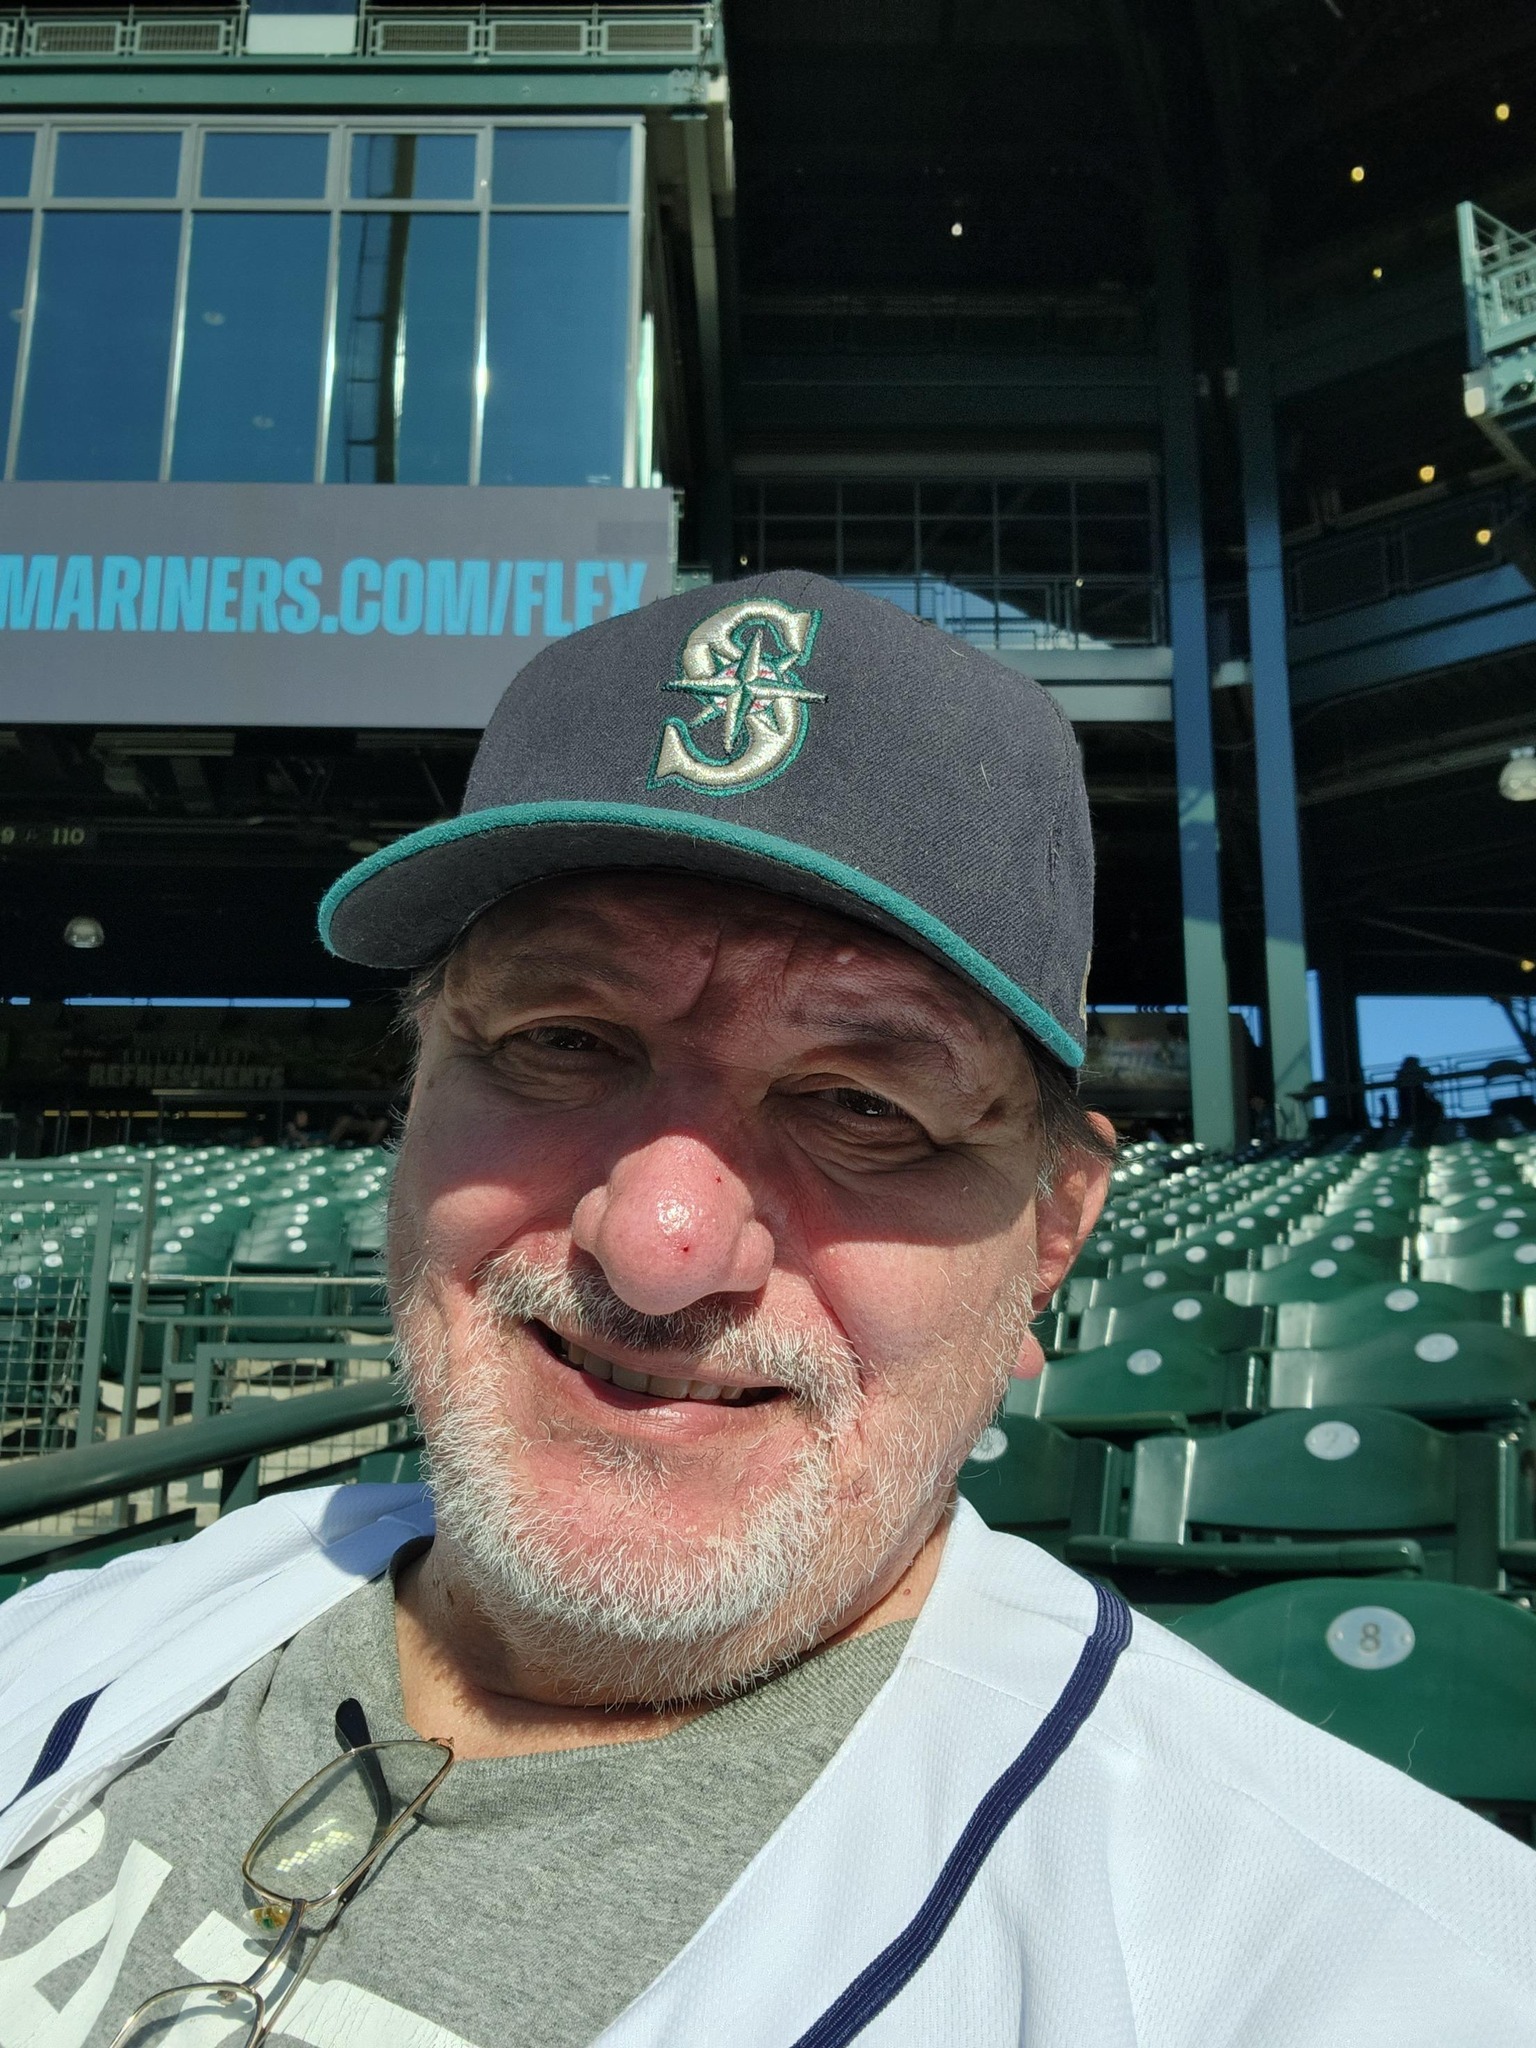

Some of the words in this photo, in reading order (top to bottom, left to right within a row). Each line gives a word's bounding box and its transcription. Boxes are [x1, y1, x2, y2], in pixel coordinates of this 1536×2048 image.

[0, 554, 648, 637] MARINERS.COM/FLEX
[52, 827, 85, 845] 110
[1360, 1622, 1380, 1653] 8
